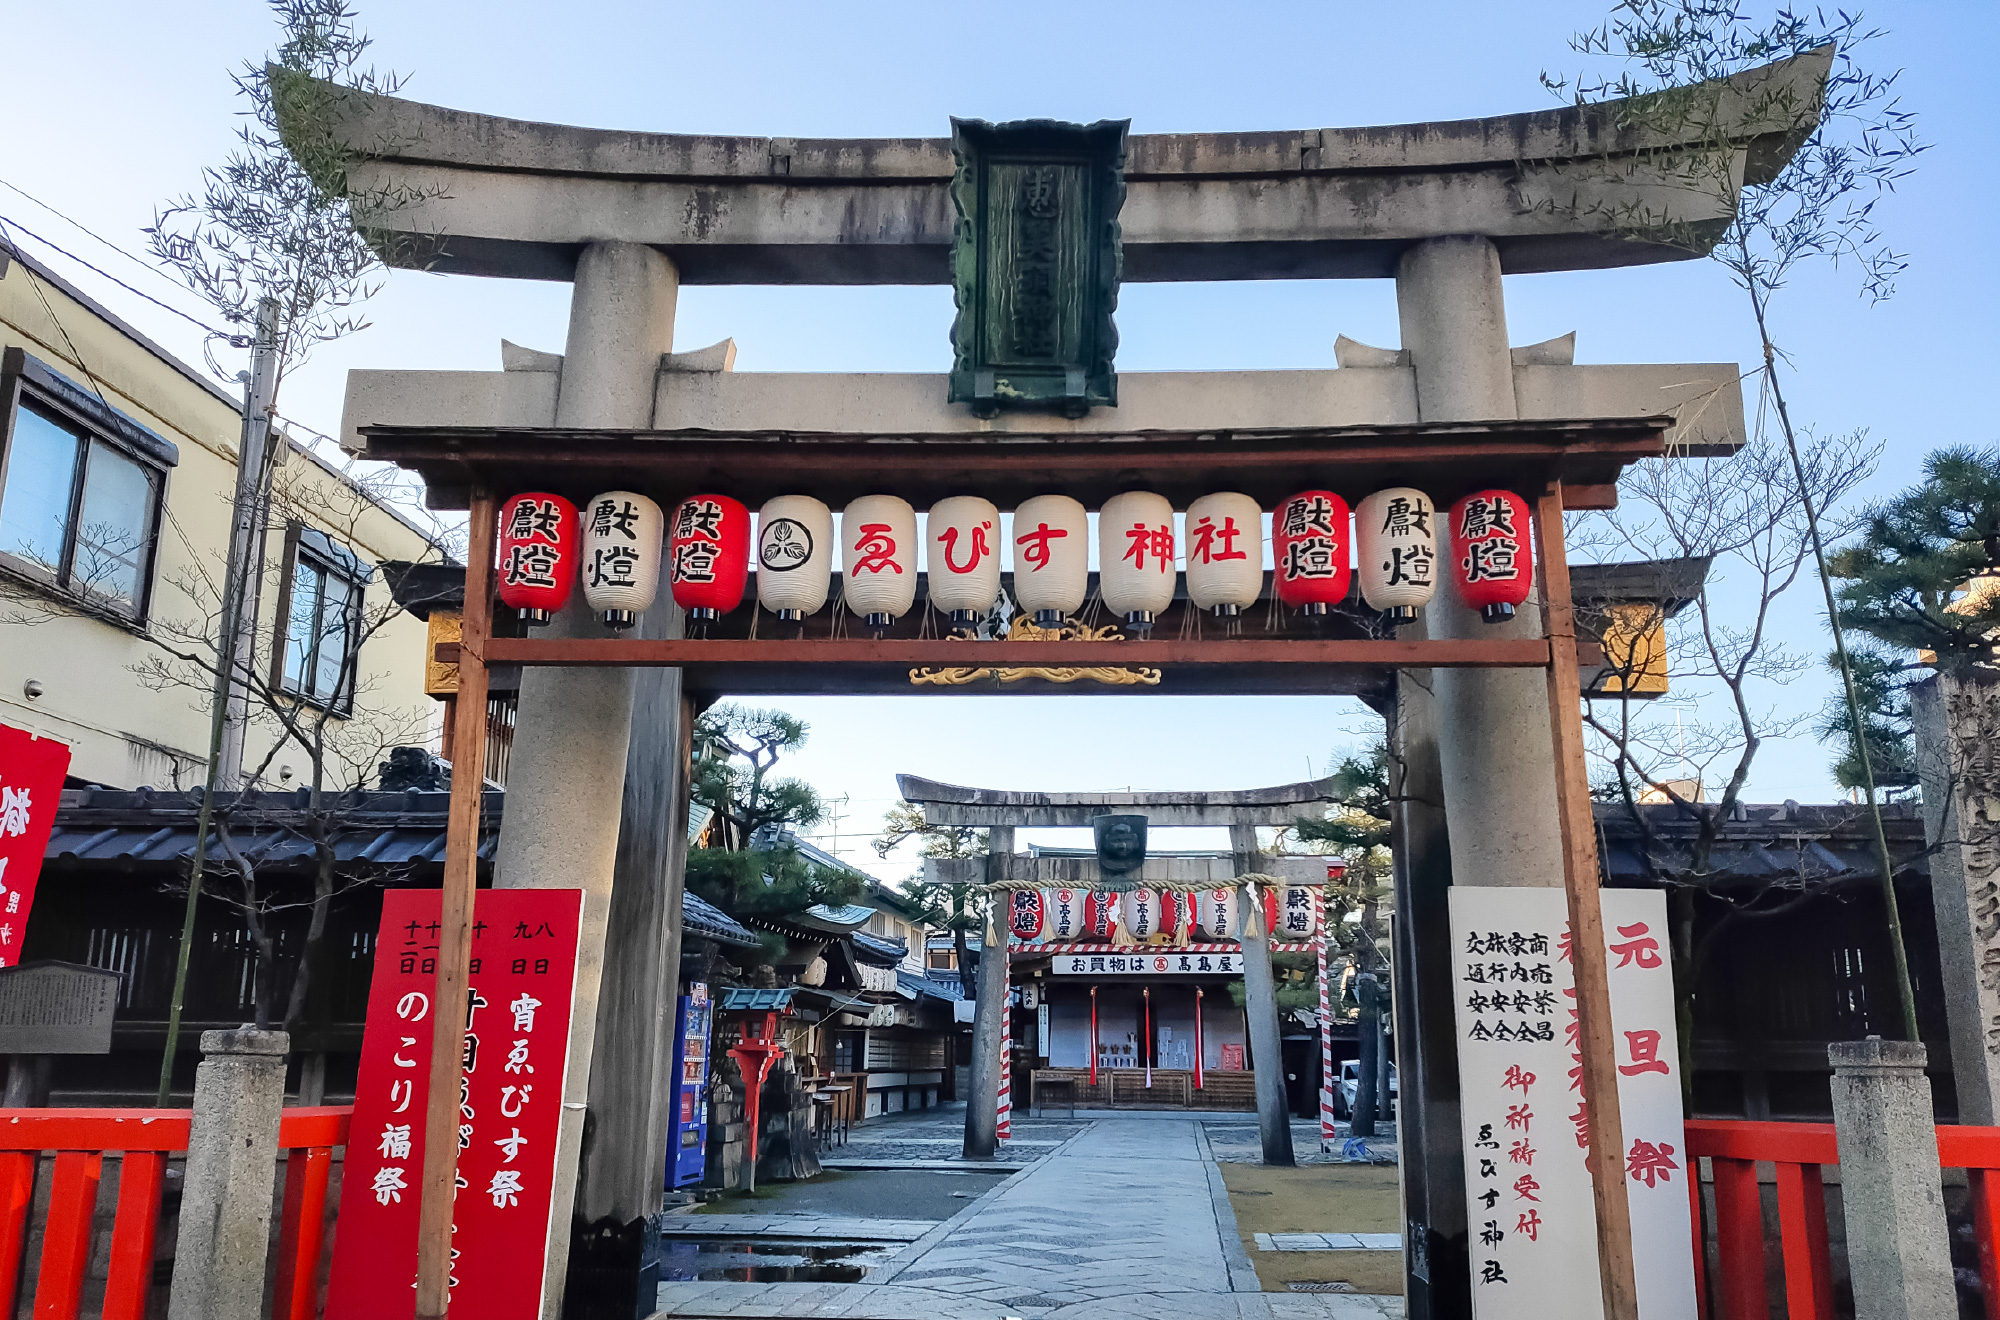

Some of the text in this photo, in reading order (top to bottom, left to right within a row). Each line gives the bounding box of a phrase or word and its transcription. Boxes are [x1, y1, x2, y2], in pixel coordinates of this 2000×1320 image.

[400, 920, 422, 974] 十二日
[512, 921, 532, 974] 九日
[534, 921, 555, 974] 八日
[1071, 957, 1145, 972] お買物は
[1463, 931, 1493, 1042] 交通安全
[1485, 931, 1515, 1042] 旅行安全
[1508, 931, 1538, 1043] 家内安全
[370, 992, 429, 1206] のこり福祭
[1610, 922, 1680, 1188] 元旦祭
